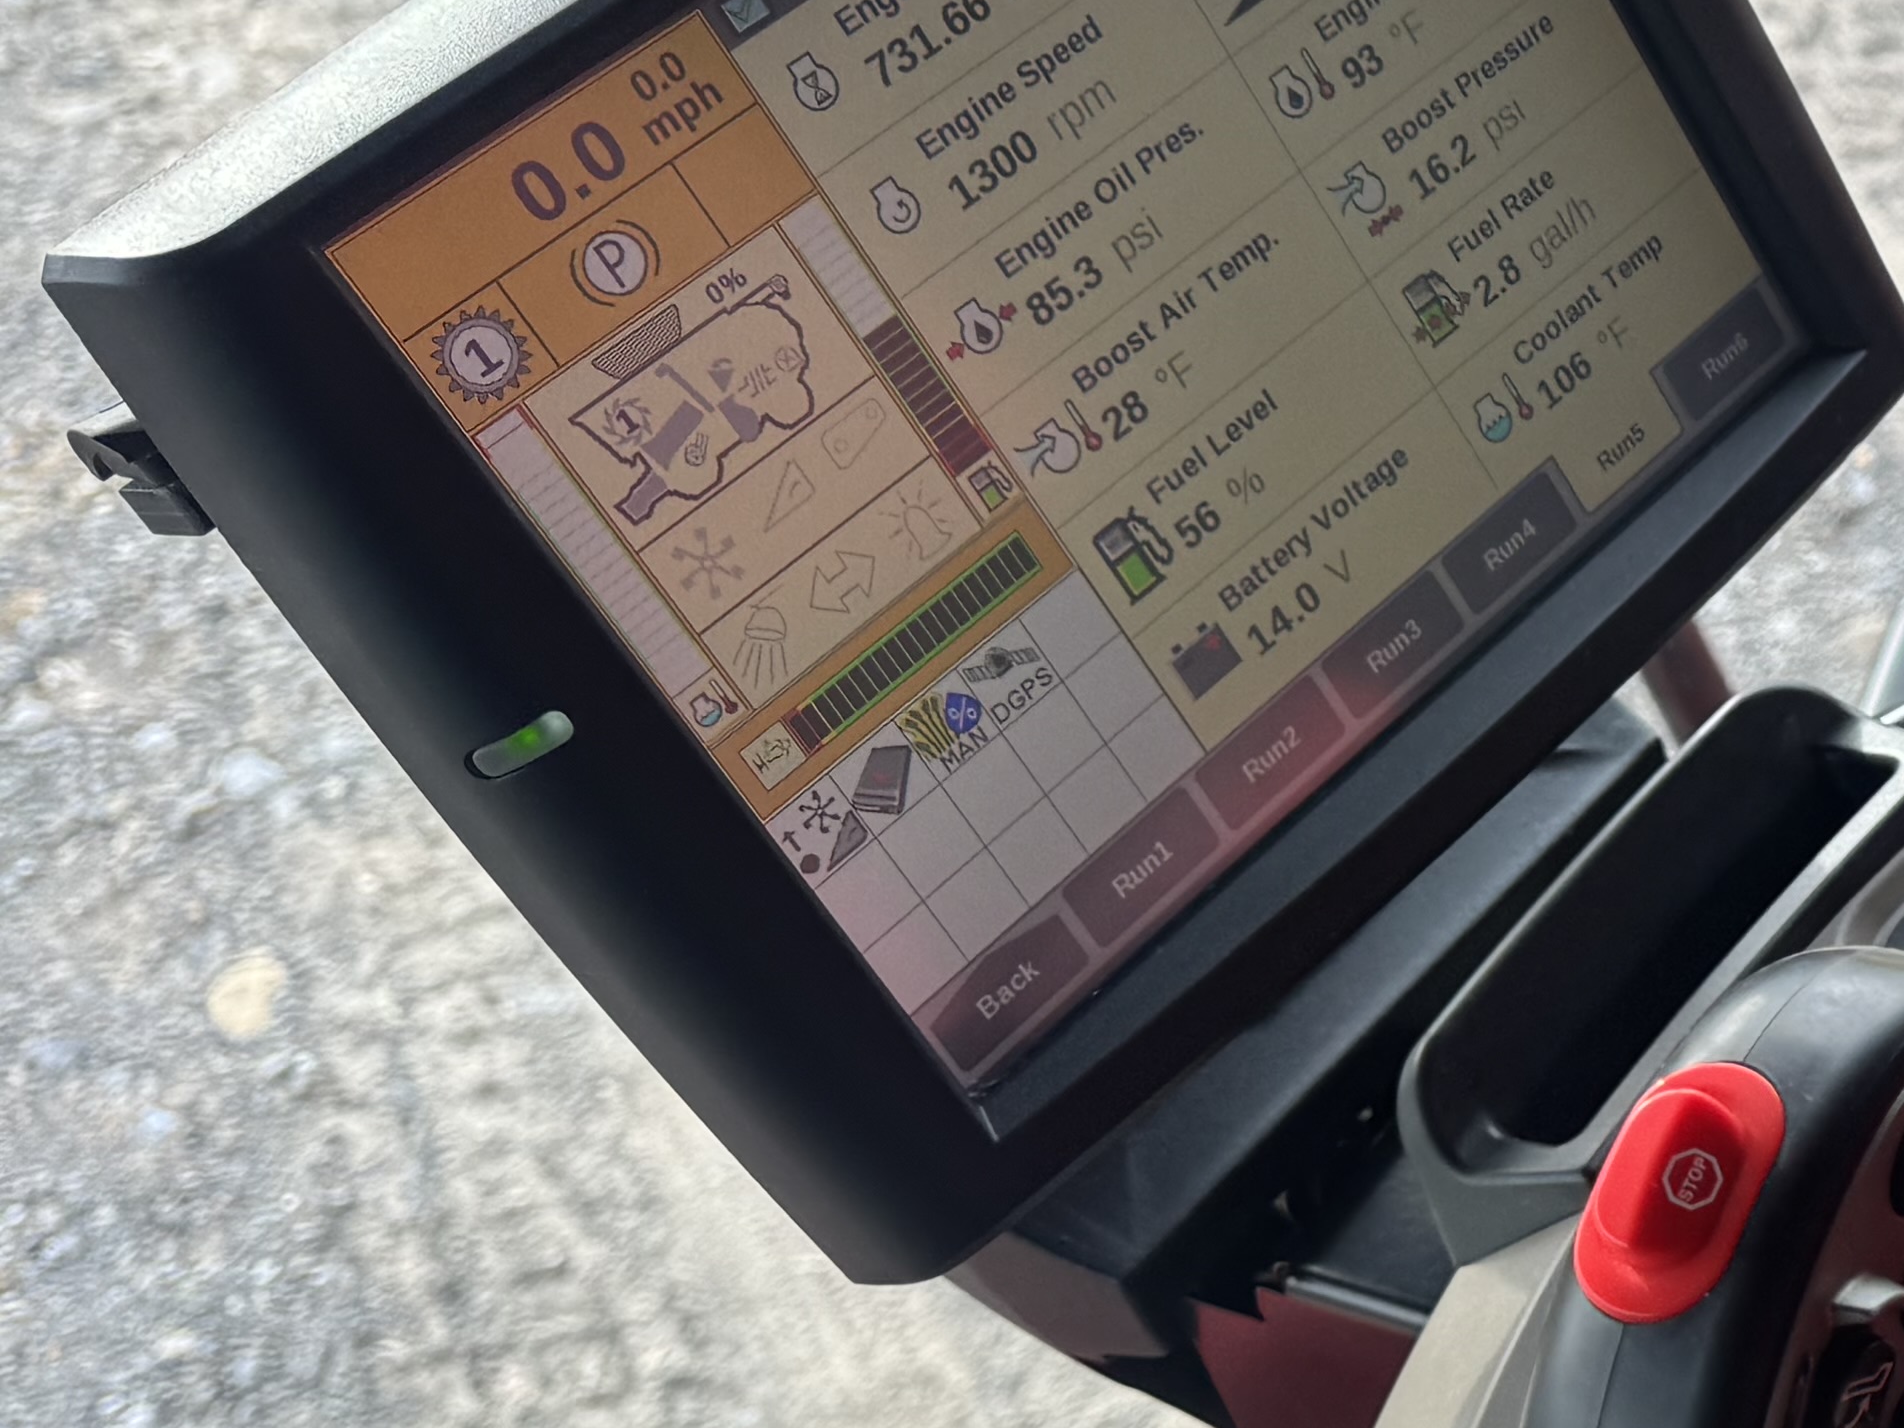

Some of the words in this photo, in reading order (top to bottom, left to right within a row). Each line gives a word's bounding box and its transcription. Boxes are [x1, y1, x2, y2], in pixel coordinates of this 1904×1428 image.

[630, 52, 687, 101] 0.0
[915, 78, 1018, 161] Engine
[1015, 15, 1104, 90] Speed
[1340, 42, 1384, 89] 93
[1389, 9, 1425, 45] °F
[1381, 88, 1456, 155] Boost
[1455, 14, 1555, 100] Pressure
[511, 121, 625, 220] 0.0
[641, 79, 724, 145] mph
[947, 130, 1038, 212] 1300
[1046, 78, 1118, 143] rpm
[1407, 134, 1478, 201] 16.2
[1481, 99, 1527, 152] psi
[994, 197, 1094, 279] Engine
[1093, 160, 1137, 205] Oil
[1135, 119, 1205, 174] Pres.
[1447, 208, 1499, 264] Fuel
[1500, 170, 1556, 220] Rate
[705, 268, 747, 304] 0%
[1025, 255, 1105, 327] 85.3
[1110, 206, 1164, 272] psi
[1472, 254, 1522, 308] 2.8
[1529, 195, 1598, 269] gal/h
[1070, 320, 1157, 394] Boost
[1158, 284, 1198, 328] Air
[1196, 228, 1281, 293] Temp.
[1513, 285, 1602, 366] Coolant
[1601, 233, 1664, 293] Temp
[464, 337, 506, 378] 1
[1101, 390, 1150, 442] 28
[1154, 350, 1194, 389] °F
[1536, 352, 1593, 410] 106
[1597, 317, 1630, 349] °F
[1701, 332, 1750, 380] Run6
[1145, 444, 1210, 505] Fuel
[1204, 388, 1279, 457] Level
[1596, 422, 1647, 473] Run5
[1173, 501, 1222, 550] 56
[1225, 467, 1267, 505] %
[1217, 522, 1314, 613] Battery
[1311, 445, 1411, 532] Voltage
[1482, 518, 1537, 572] Run4
[1245, 582, 1322, 657] 14.0
[1323, 549, 1353, 584] V
[1366, 617, 1424, 675] Run3
[989, 666, 1054, 725] DGPS
[938, 727, 990, 774] MAN
[1240, 724, 1303, 785] Run2
[1111, 841, 1175, 899] Run1
[975, 958, 1041, 1020] Back
[1678, 1156, 1706, 1202] STOP
